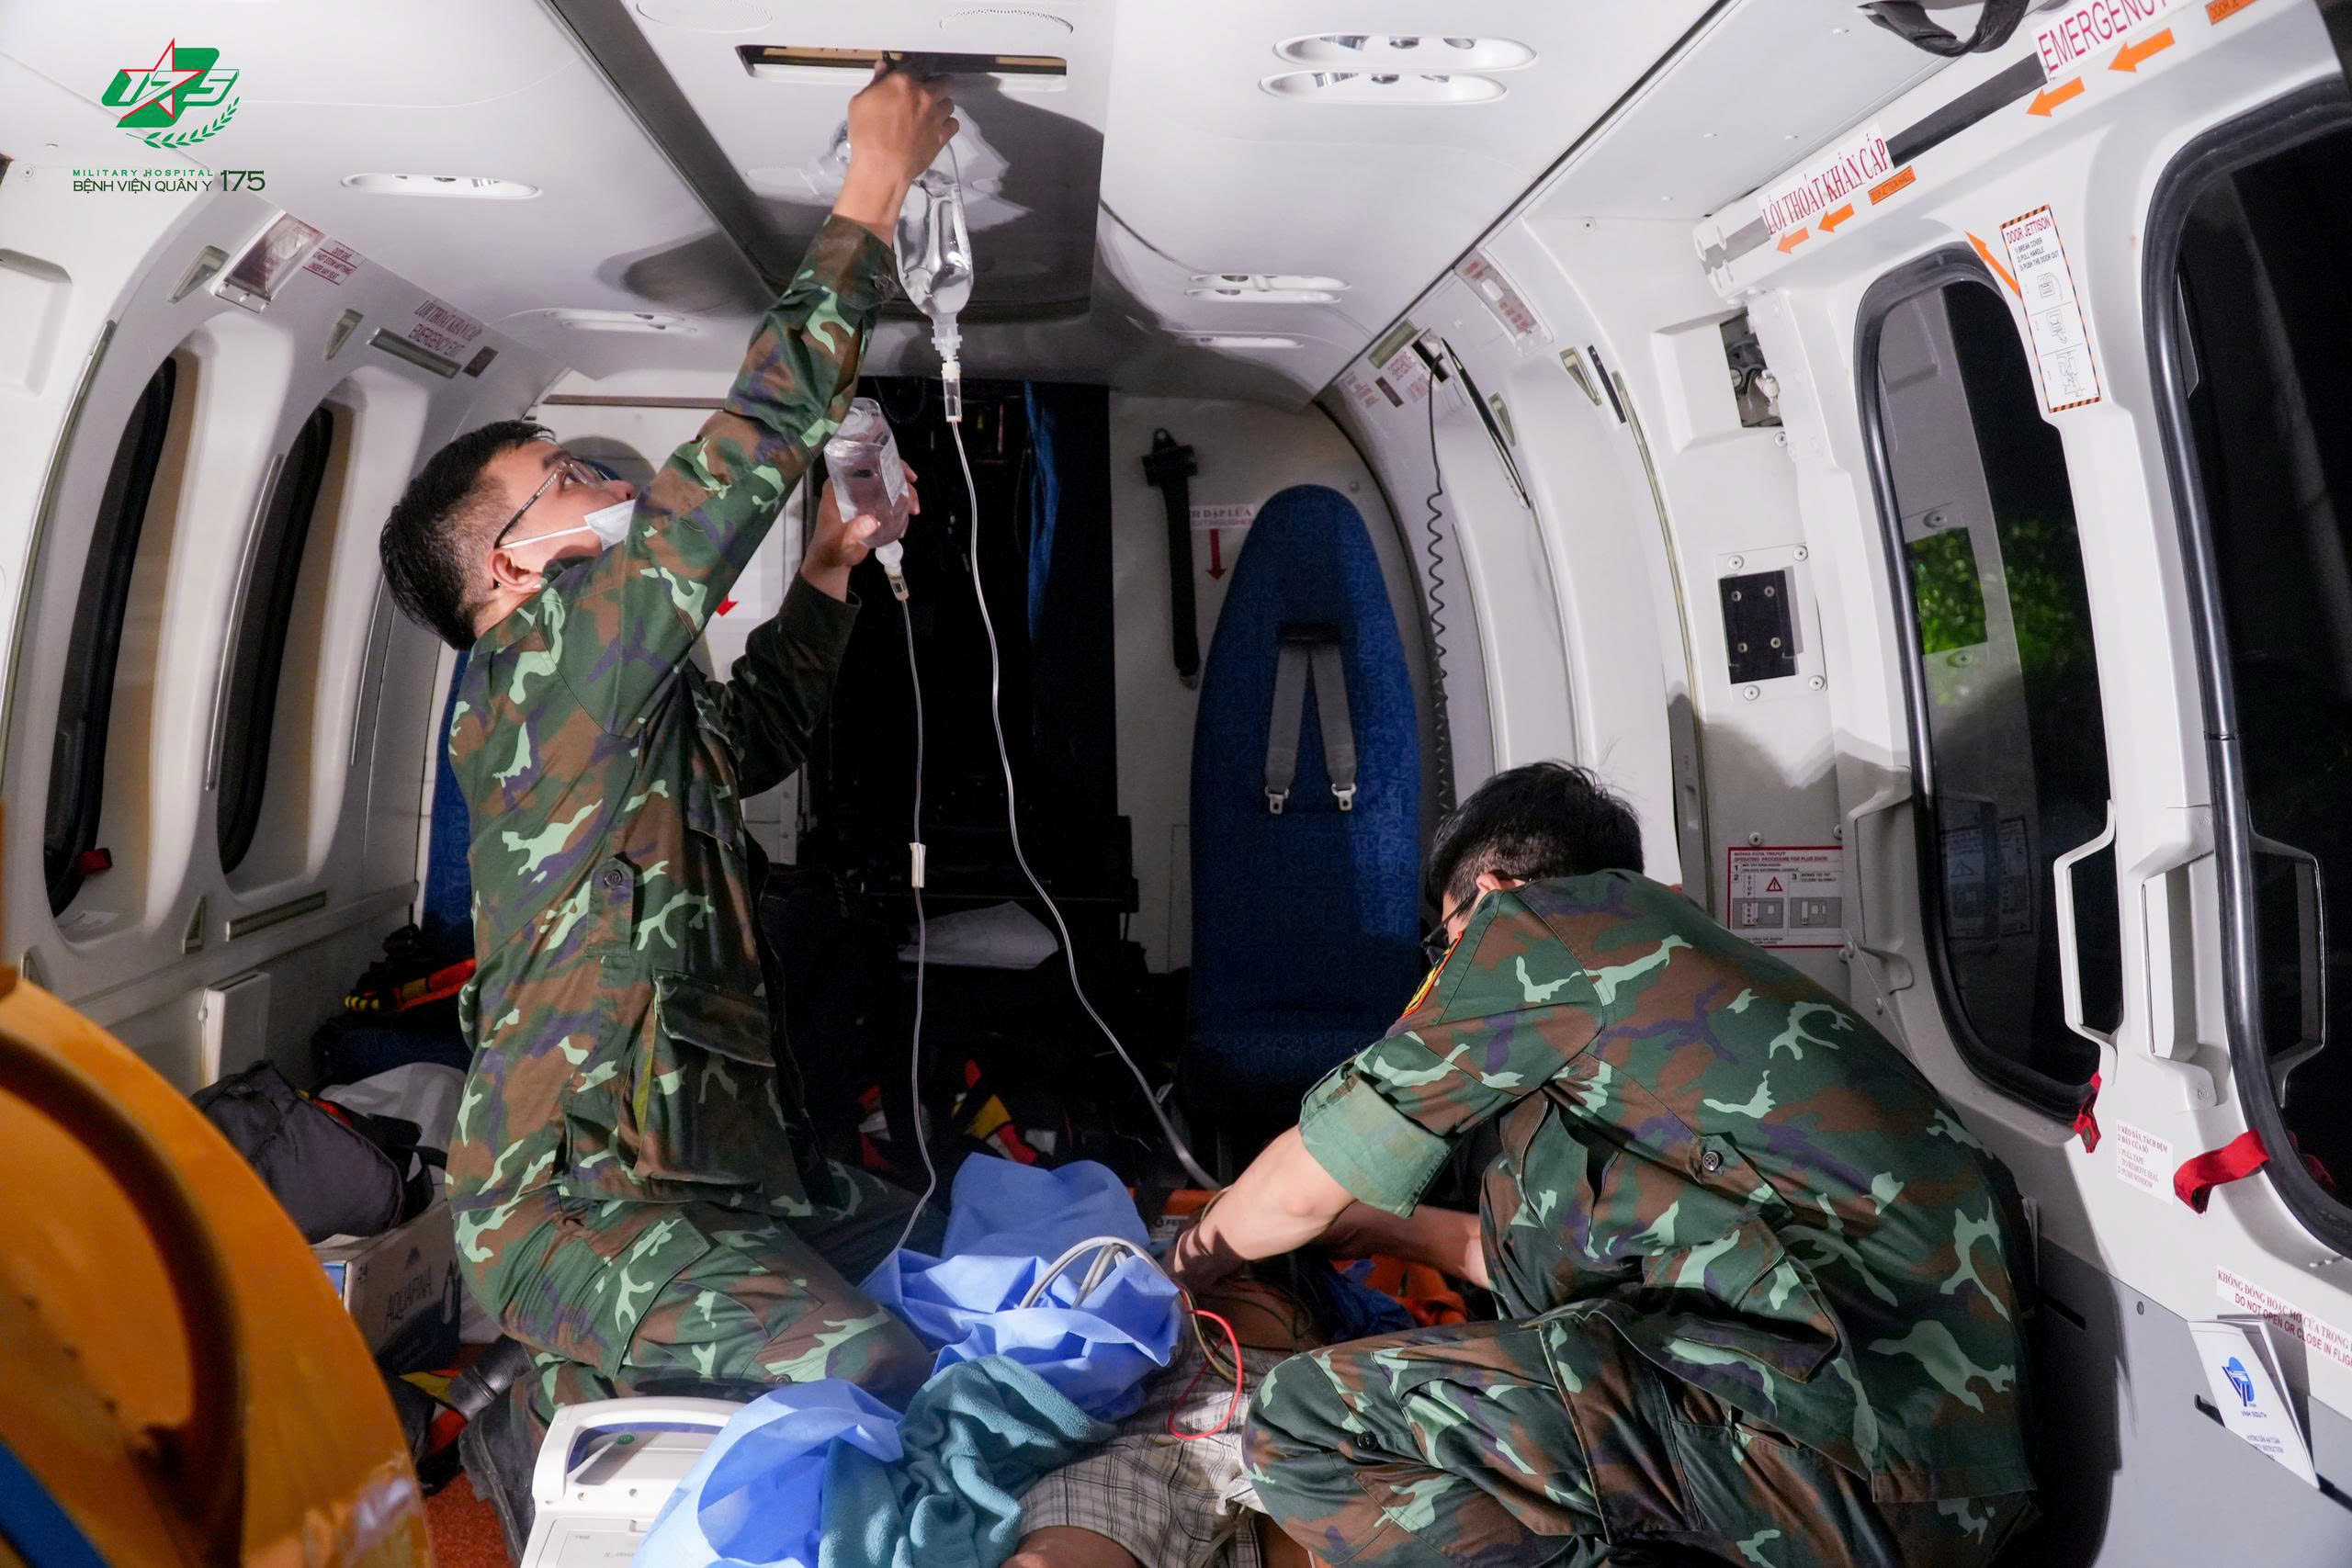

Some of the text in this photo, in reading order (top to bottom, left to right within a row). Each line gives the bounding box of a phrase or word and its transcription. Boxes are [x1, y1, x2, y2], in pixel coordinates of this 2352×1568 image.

[1782, 174, 1826, 223] THOÁT
[2006, 216, 2051, 244] DOOR JETTISON
[386, 1266, 434, 1323] AQUAFINA
[2217, 1269, 2244, 1292] KHÔNG
[2245, 1282, 2266, 1304] ĐÓNG
[2321, 1323, 2349, 1349] TRONG
[2234, 1292, 2246, 1307] DO
[2246, 1300, 2262, 1315] NOT
[2263, 1309, 2283, 1329] OPEN
[2284, 1321, 2296, 1337] OR
[2296, 1327, 2323, 1350] CLOSE
[2324, 1343, 2333, 1357] IN
